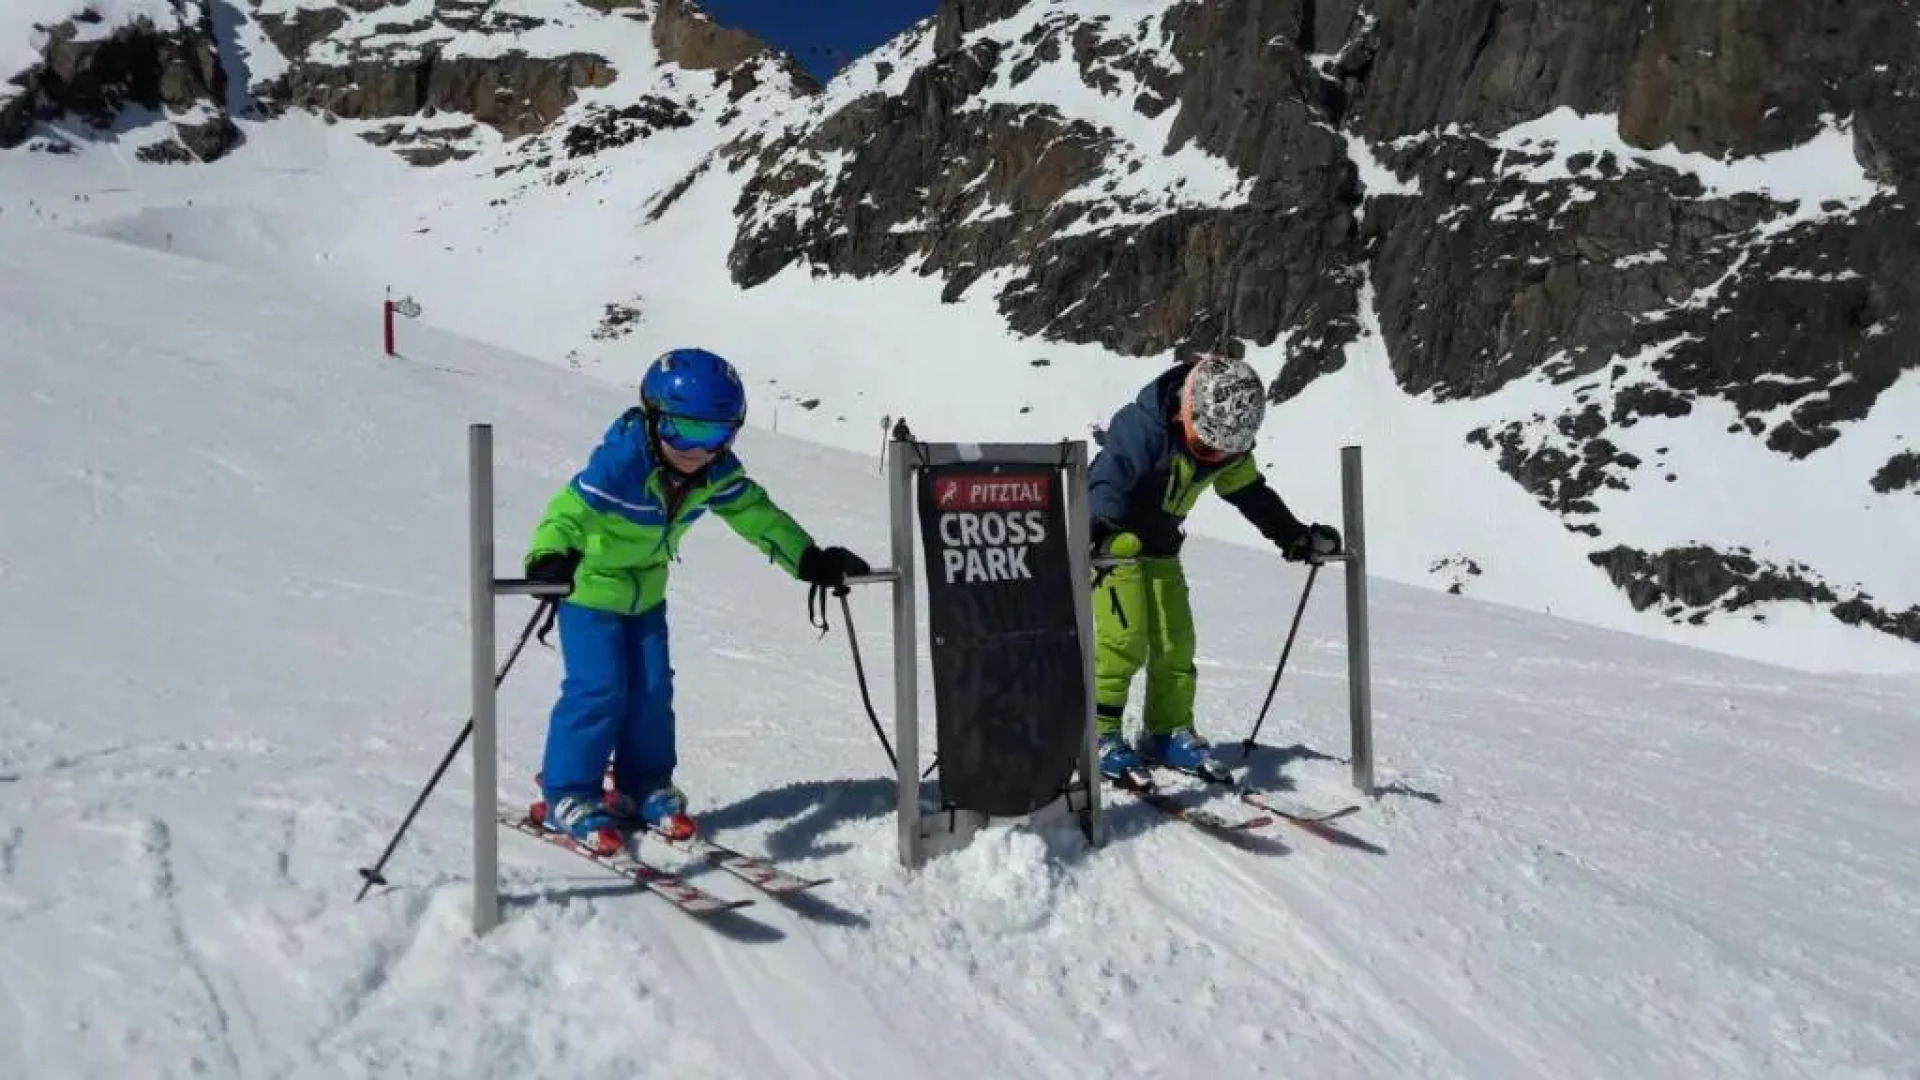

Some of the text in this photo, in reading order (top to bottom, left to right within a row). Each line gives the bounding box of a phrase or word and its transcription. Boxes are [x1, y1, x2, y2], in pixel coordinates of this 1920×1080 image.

[970, 482, 1042, 503] PITZTAL
[940, 510, 1046, 546] CROSS
[942, 546, 1032, 584] PARK
